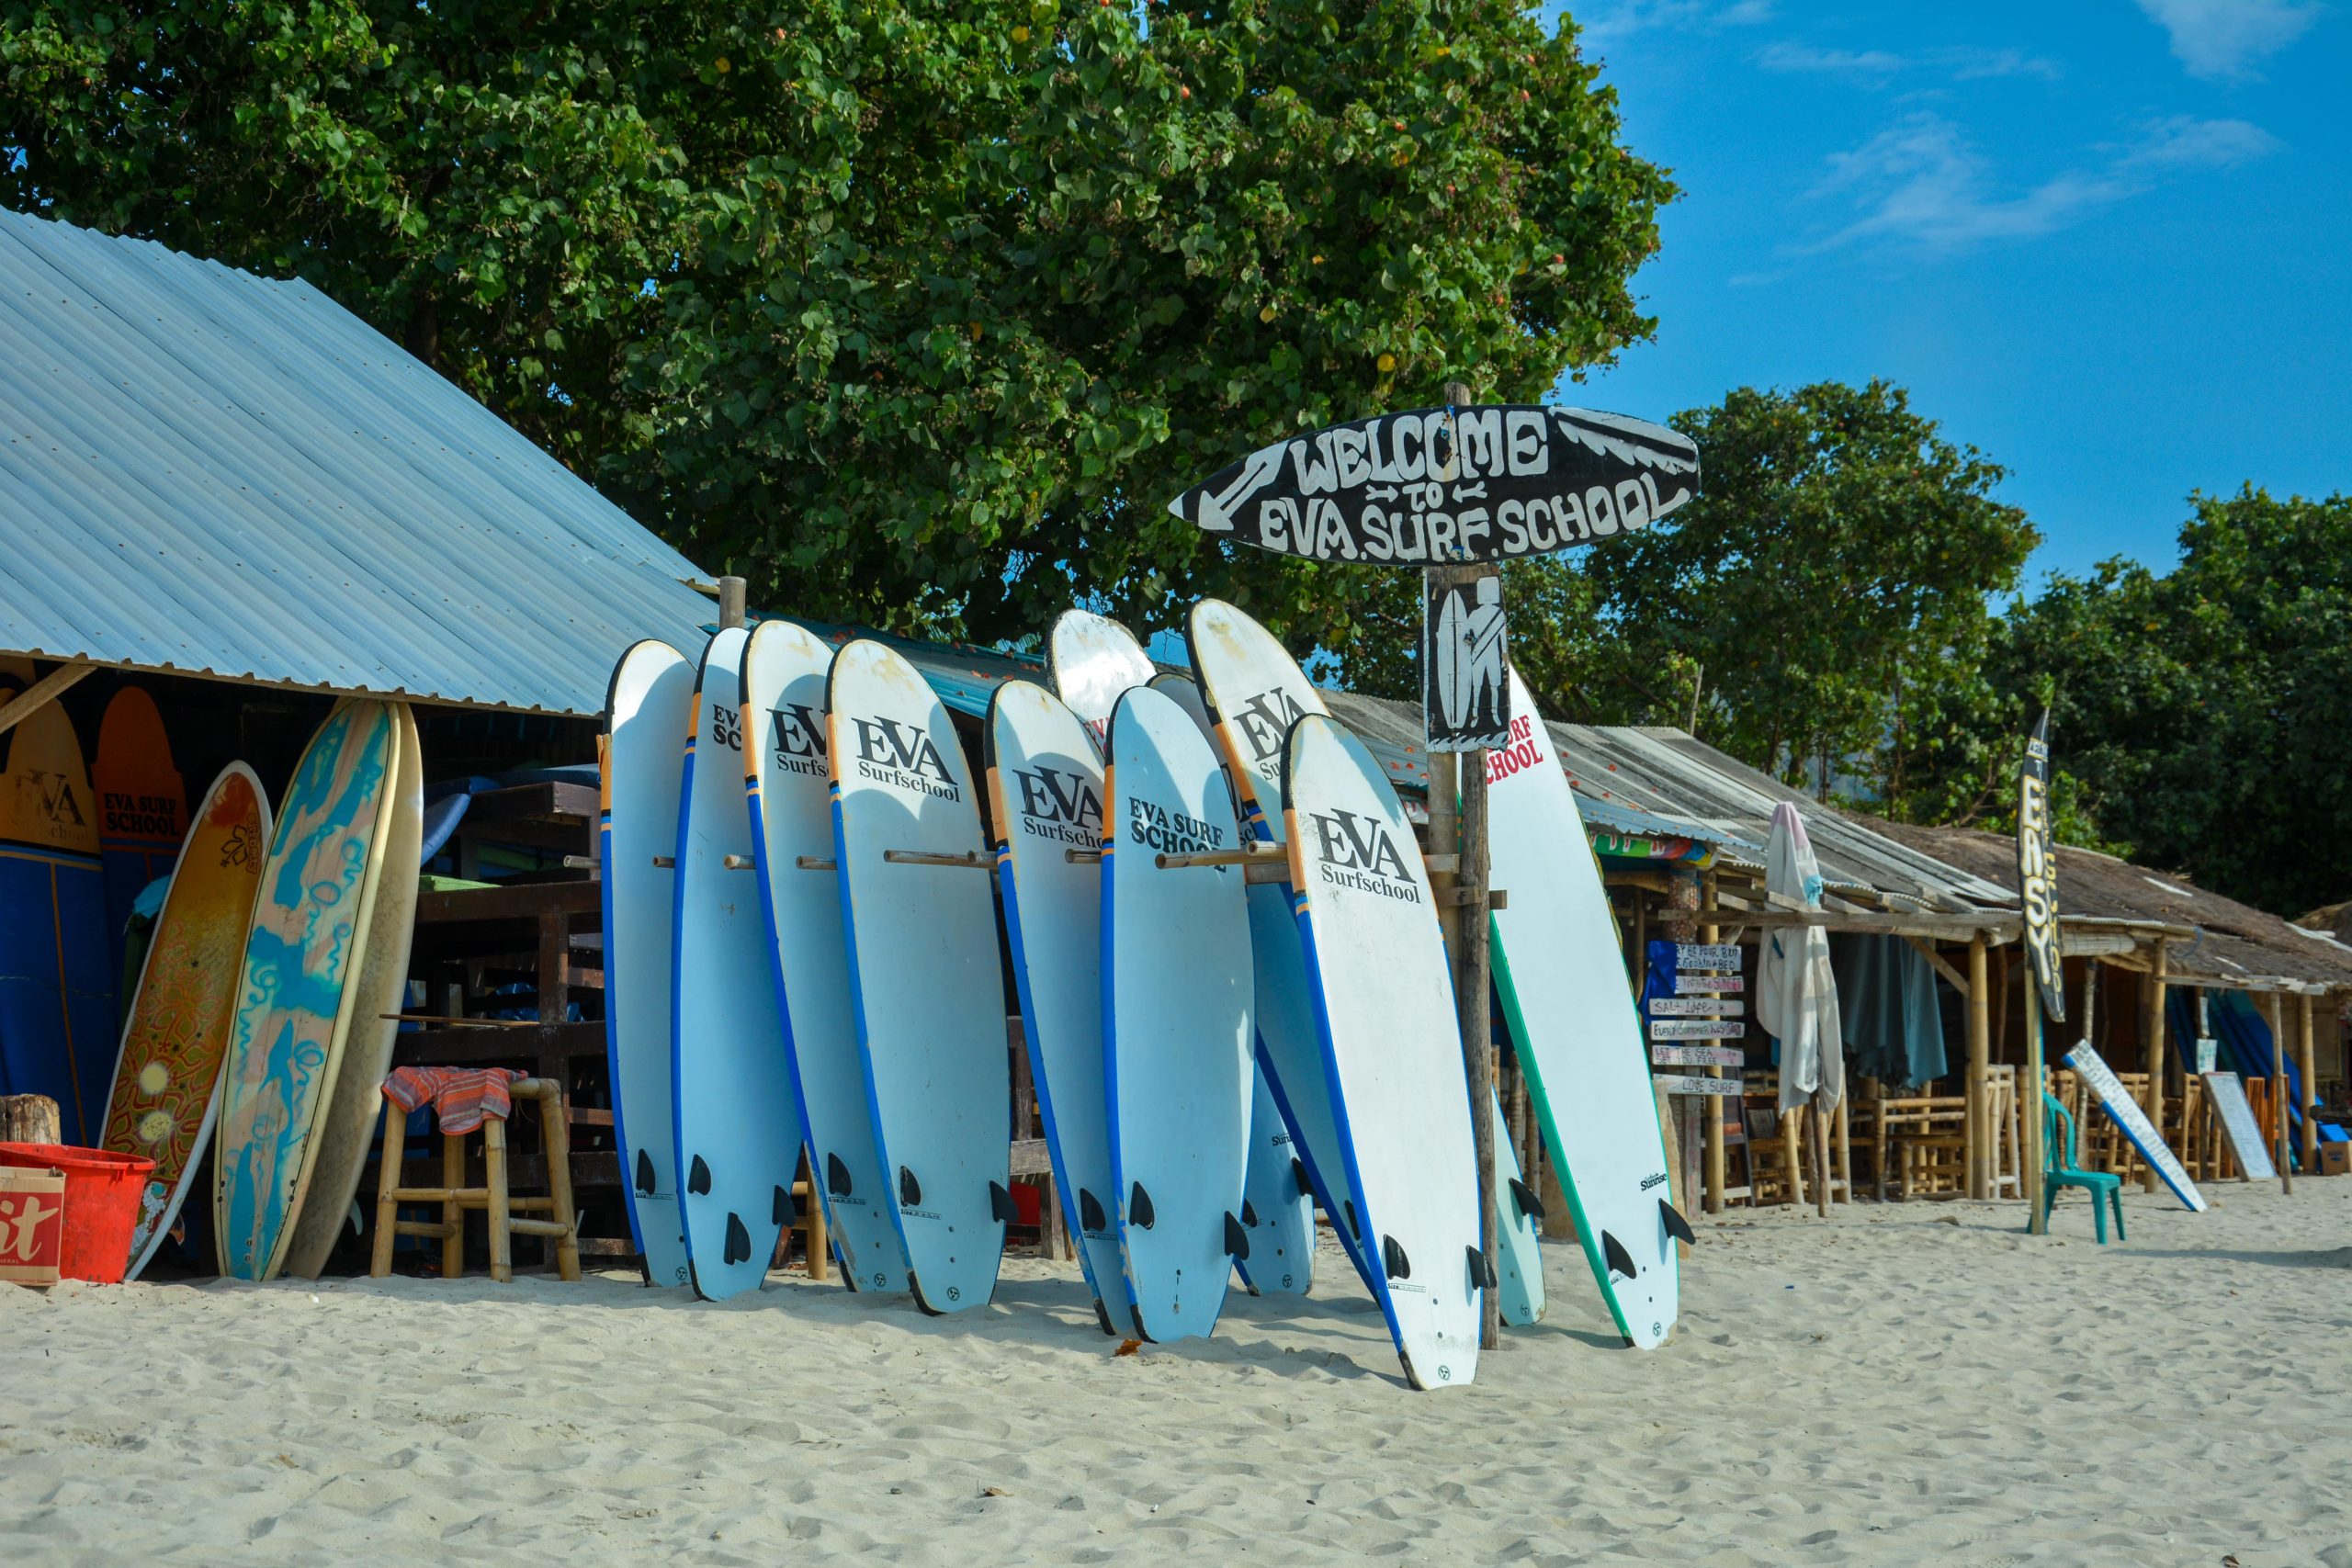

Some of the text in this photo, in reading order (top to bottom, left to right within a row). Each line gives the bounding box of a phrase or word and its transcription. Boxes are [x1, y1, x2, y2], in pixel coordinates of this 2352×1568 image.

[1288, 410, 1550, 496] WELCOME
[1402, 482, 1444, 512] TO
[1497, 470, 1691, 553] SCHOOL
[713, 704, 741, 731] EV
[765, 703, 827, 758] EV
[776, 753, 828, 777] Surfs
[851, 716, 958, 785] EVA
[1487, 739, 1544, 785] CHOOL
[15, 768, 86, 826] VA
[858, 761, 961, 804] Surfschool
[1012, 764, 1102, 831] EVA
[104, 793, 176, 816] EVA SURF
[107, 812, 182, 838] SCHOOL
[1128, 796, 1170, 829] EVA
[1173, 813, 1224, 847] SURF
[1309, 807, 1417, 884] EVA
[1321, 863, 1421, 905] Surfschool
[2022, 774, 2052, 985] EASY
[1718, 959, 1736, 970] BED
[1676, 1048, 1690, 1056] THE
[1695, 1048, 1713, 1056] SEA
[1677, 1056, 1692, 1065] YOU
[1697, 1056, 1718, 1066] FREE
[1709, 1080, 1735, 1094] SURF
[1641, 1172, 1668, 1191] Sunrise
[0, 1196, 59, 1262] it
